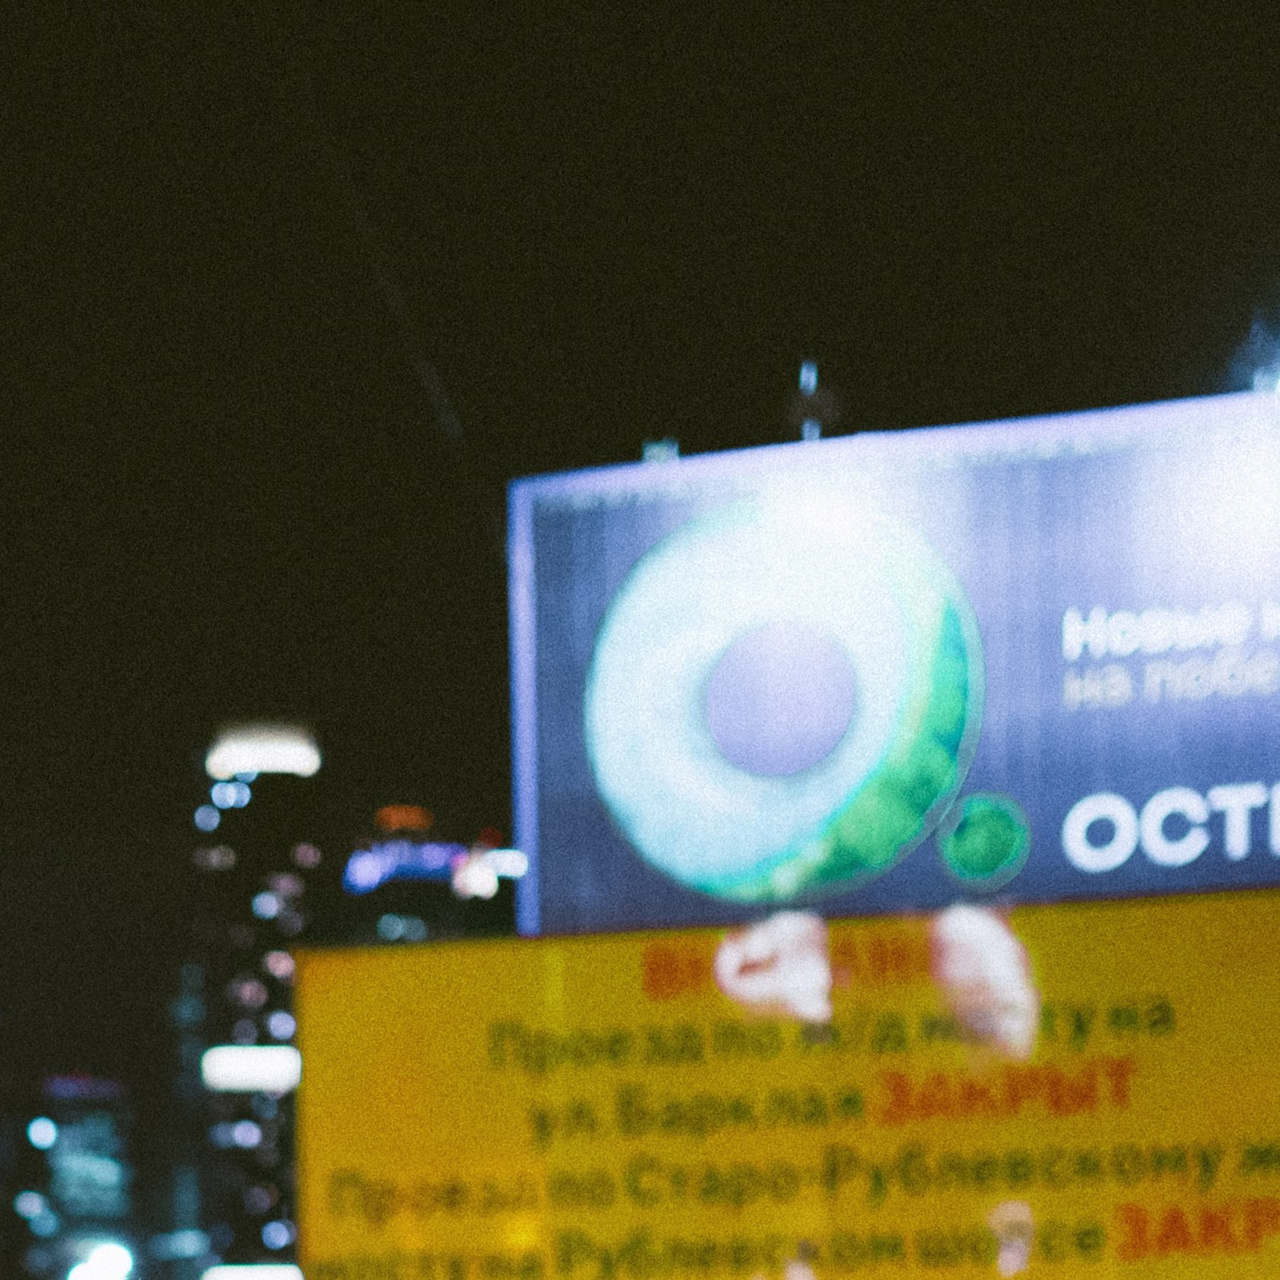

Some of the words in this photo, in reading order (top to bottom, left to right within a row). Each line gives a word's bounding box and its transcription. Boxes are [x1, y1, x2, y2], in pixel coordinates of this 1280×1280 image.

[488, 1020, 706, 1078] Проезд
[920, 1003, 1098, 1053] мту
[617, 1083, 864, 1138] Барклая
[880, 1056, 1135, 1127] ЗАКРЫТ
[915, 1222, 1104, 1270] шосе
